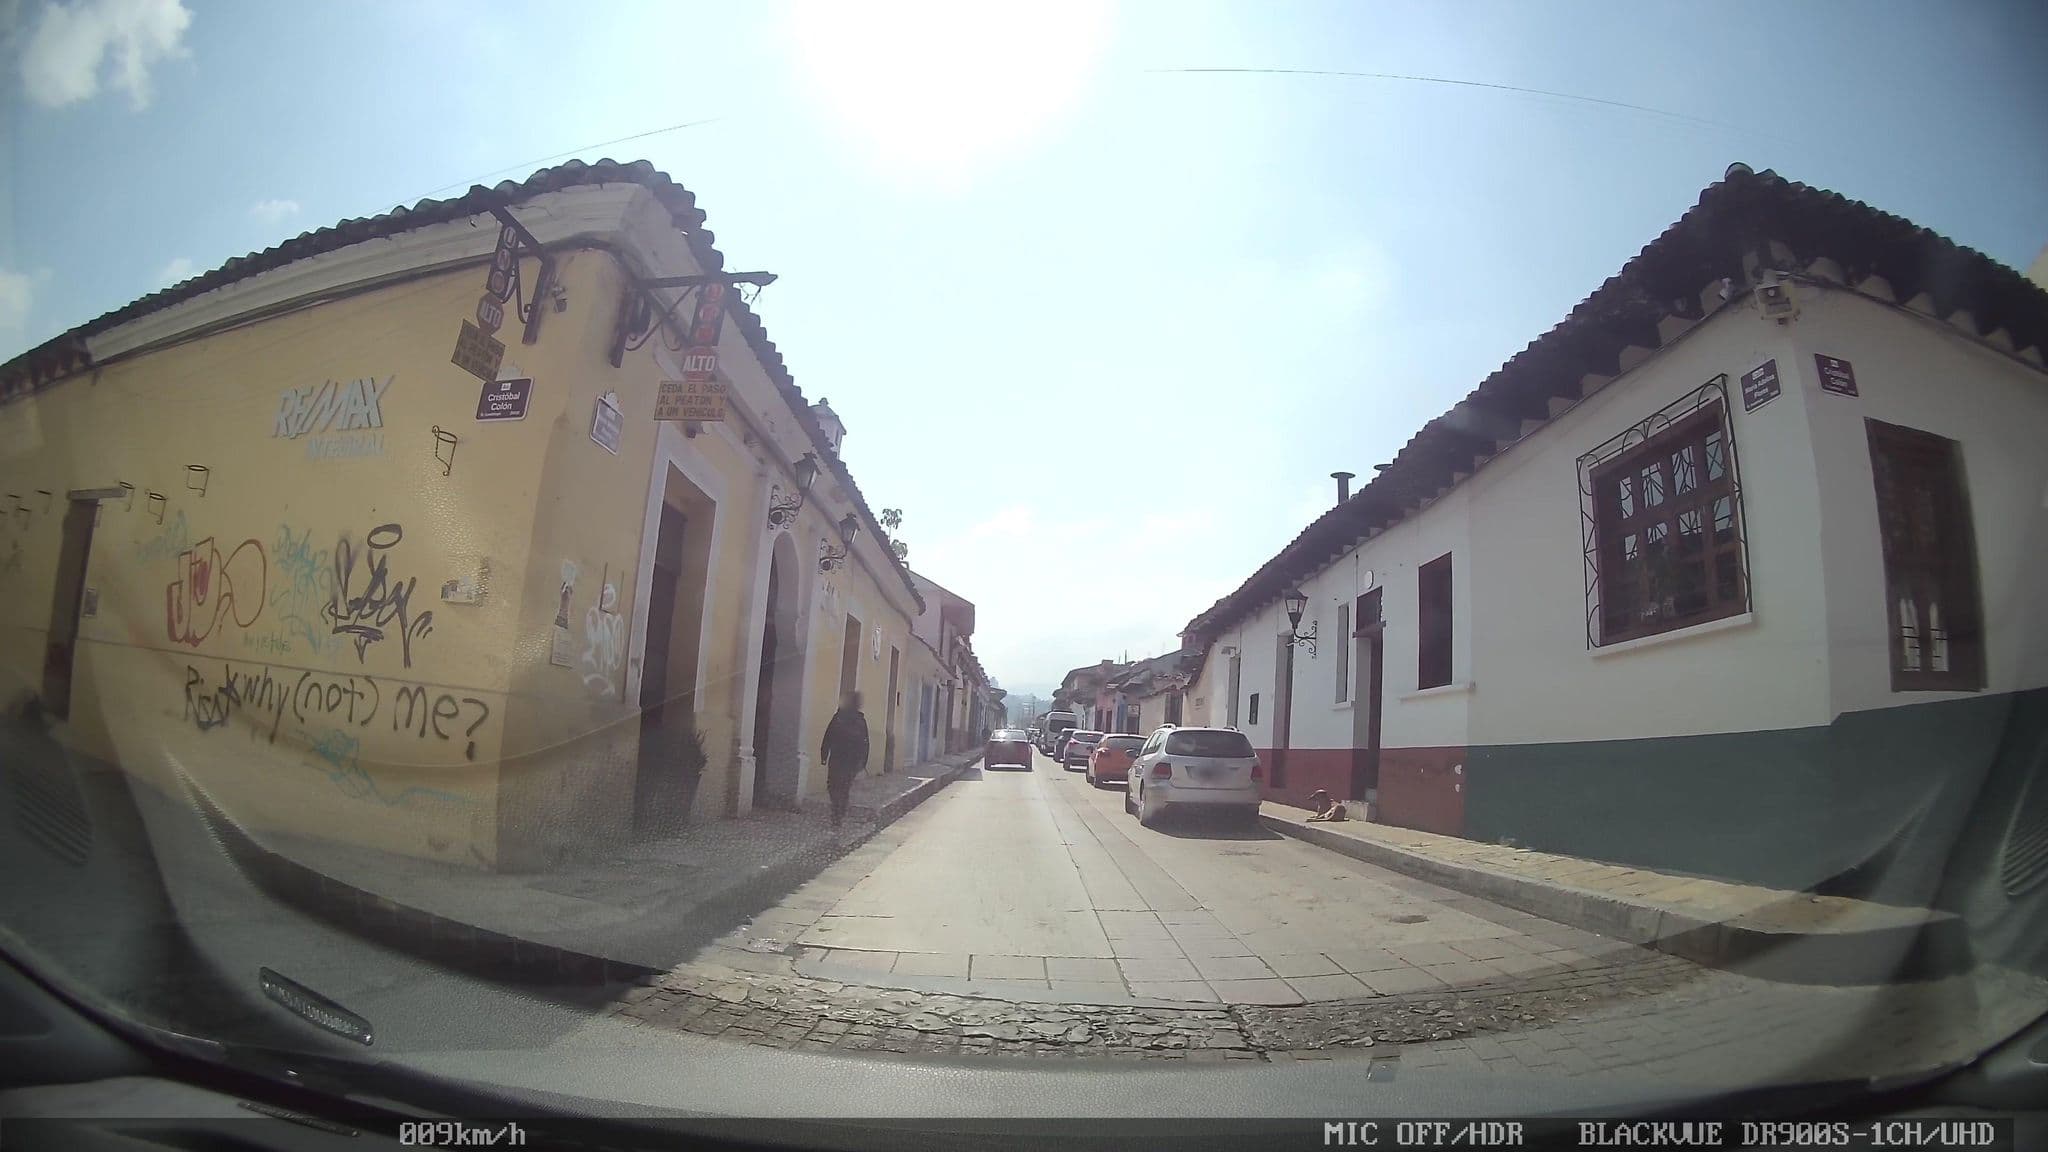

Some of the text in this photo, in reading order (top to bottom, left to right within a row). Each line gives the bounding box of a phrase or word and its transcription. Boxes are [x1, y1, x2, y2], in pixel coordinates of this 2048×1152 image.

[682, 355, 716, 372] ALTO
[661, 384, 727, 394] CEDA EL PASO
[488, 391, 520, 402] Cristóbal
[659, 395, 671, 405] AL
[719, 395, 727, 406] Y
[270, 374, 396, 440] RE/MAX
[491, 402, 512, 411] Colón
[656, 407, 665, 417] A
[294, 671, 380, 727] (not)
